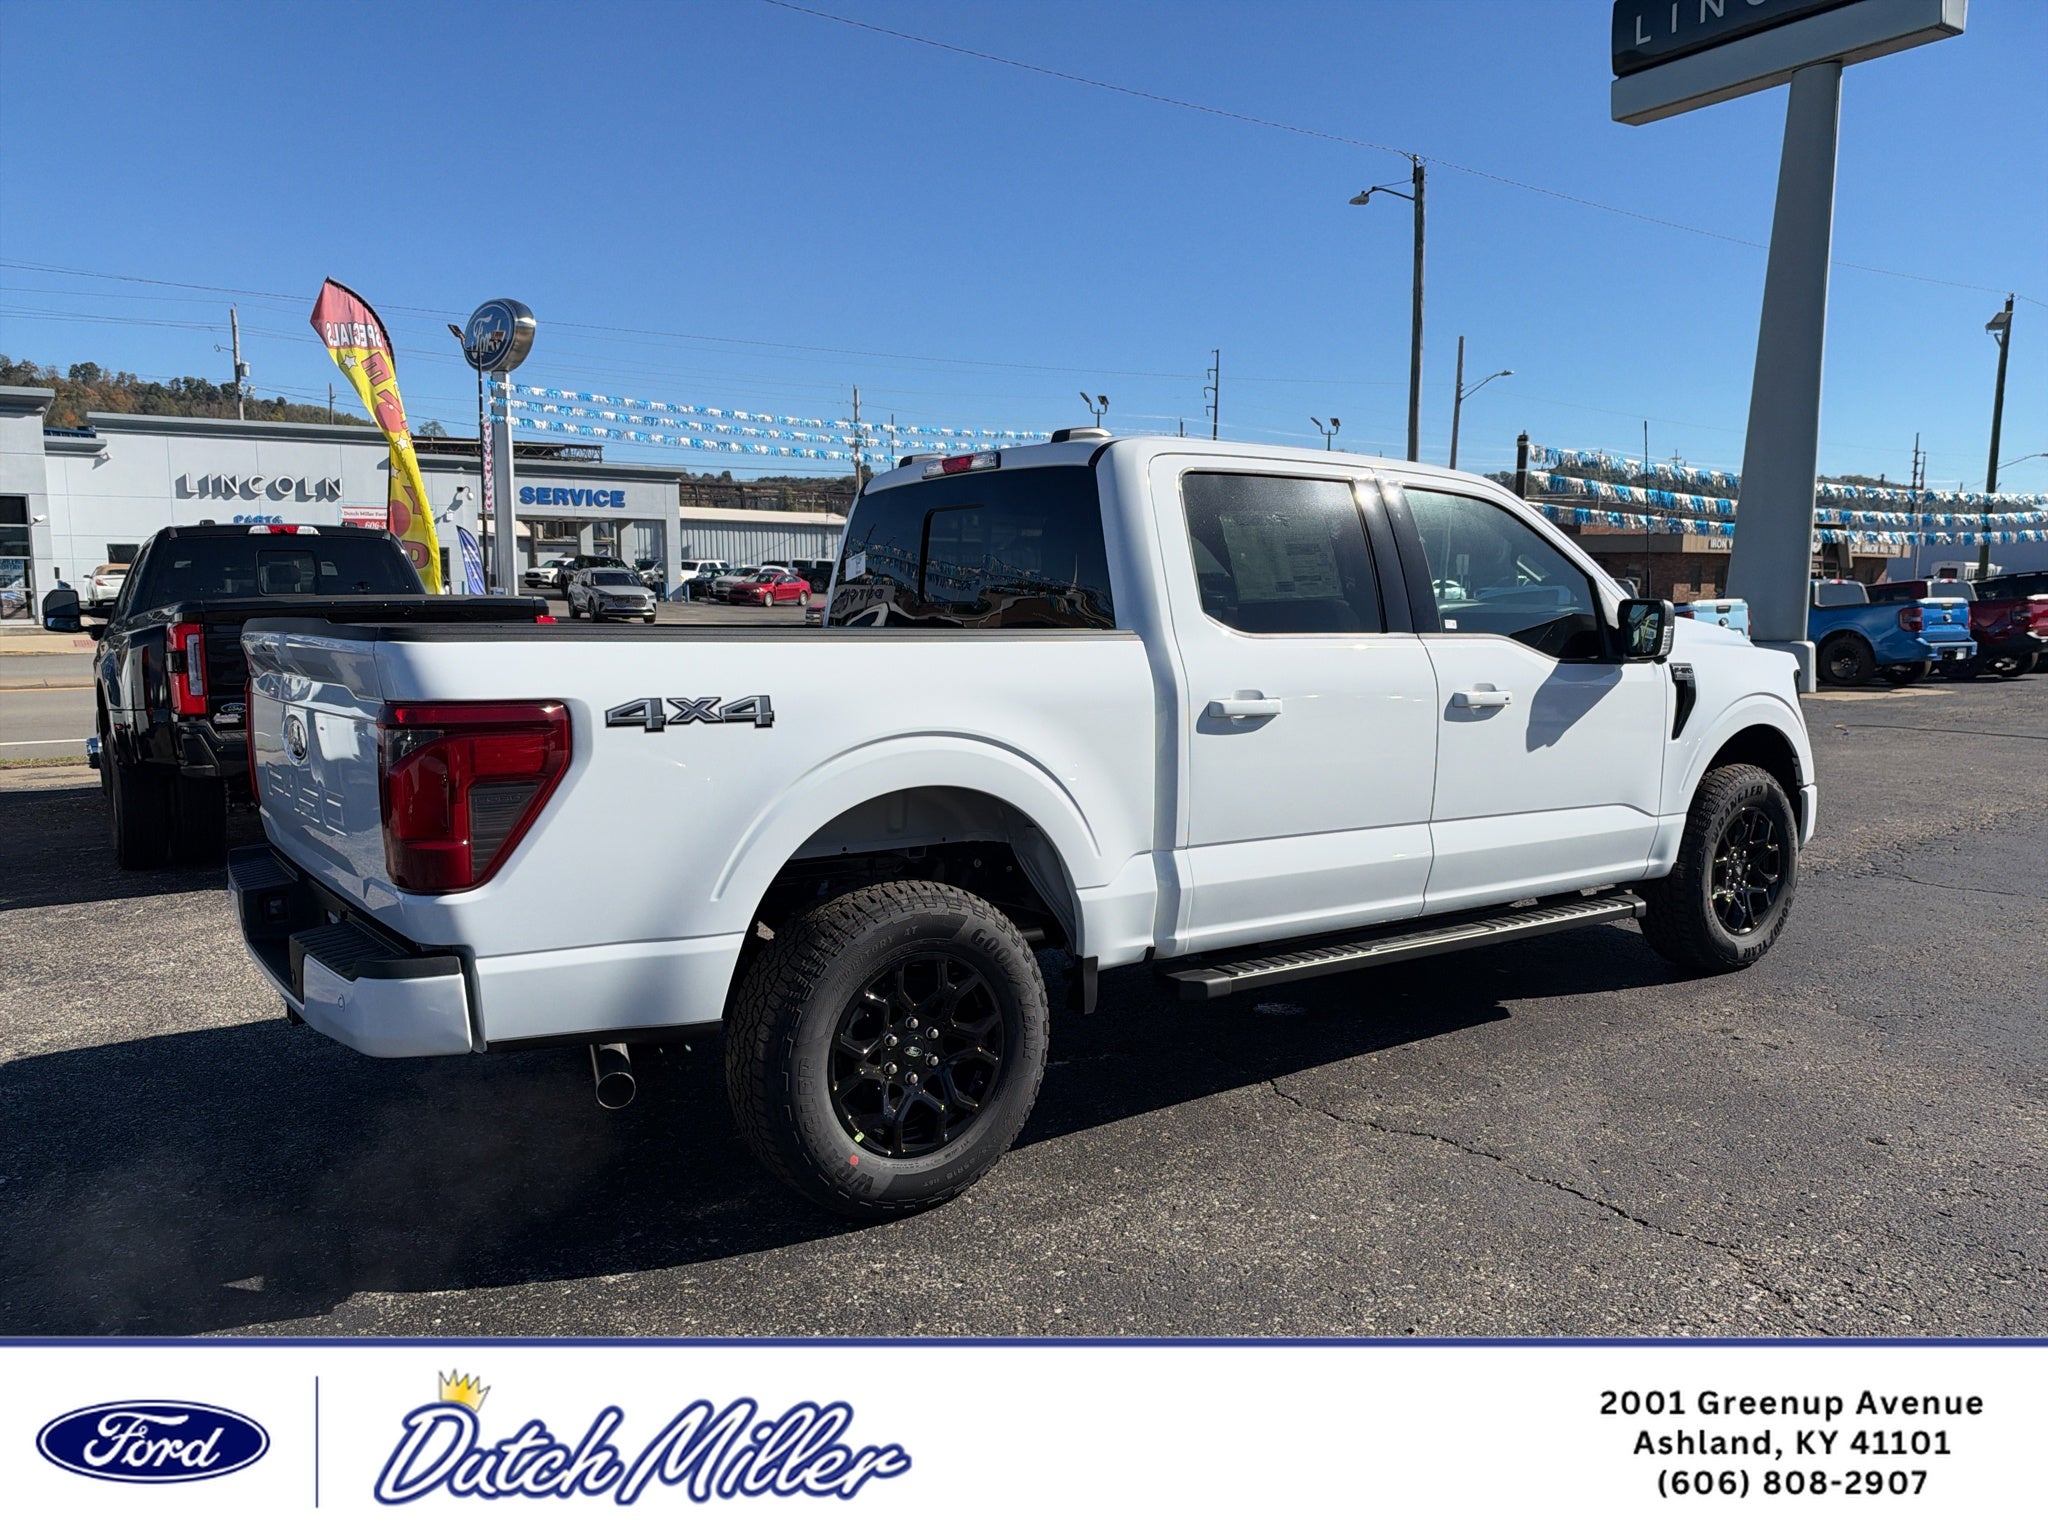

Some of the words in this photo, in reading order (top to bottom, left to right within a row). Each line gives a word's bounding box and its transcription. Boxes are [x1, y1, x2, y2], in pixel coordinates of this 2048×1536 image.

[1635, 0, 1766, 46] LIN
[185, 472, 342, 497] LINCOLN
[519, 486, 626, 509] SERVICE
[232, 514, 283, 525] PARTS
[969, 927, 1041, 1061] GOODYEAR
